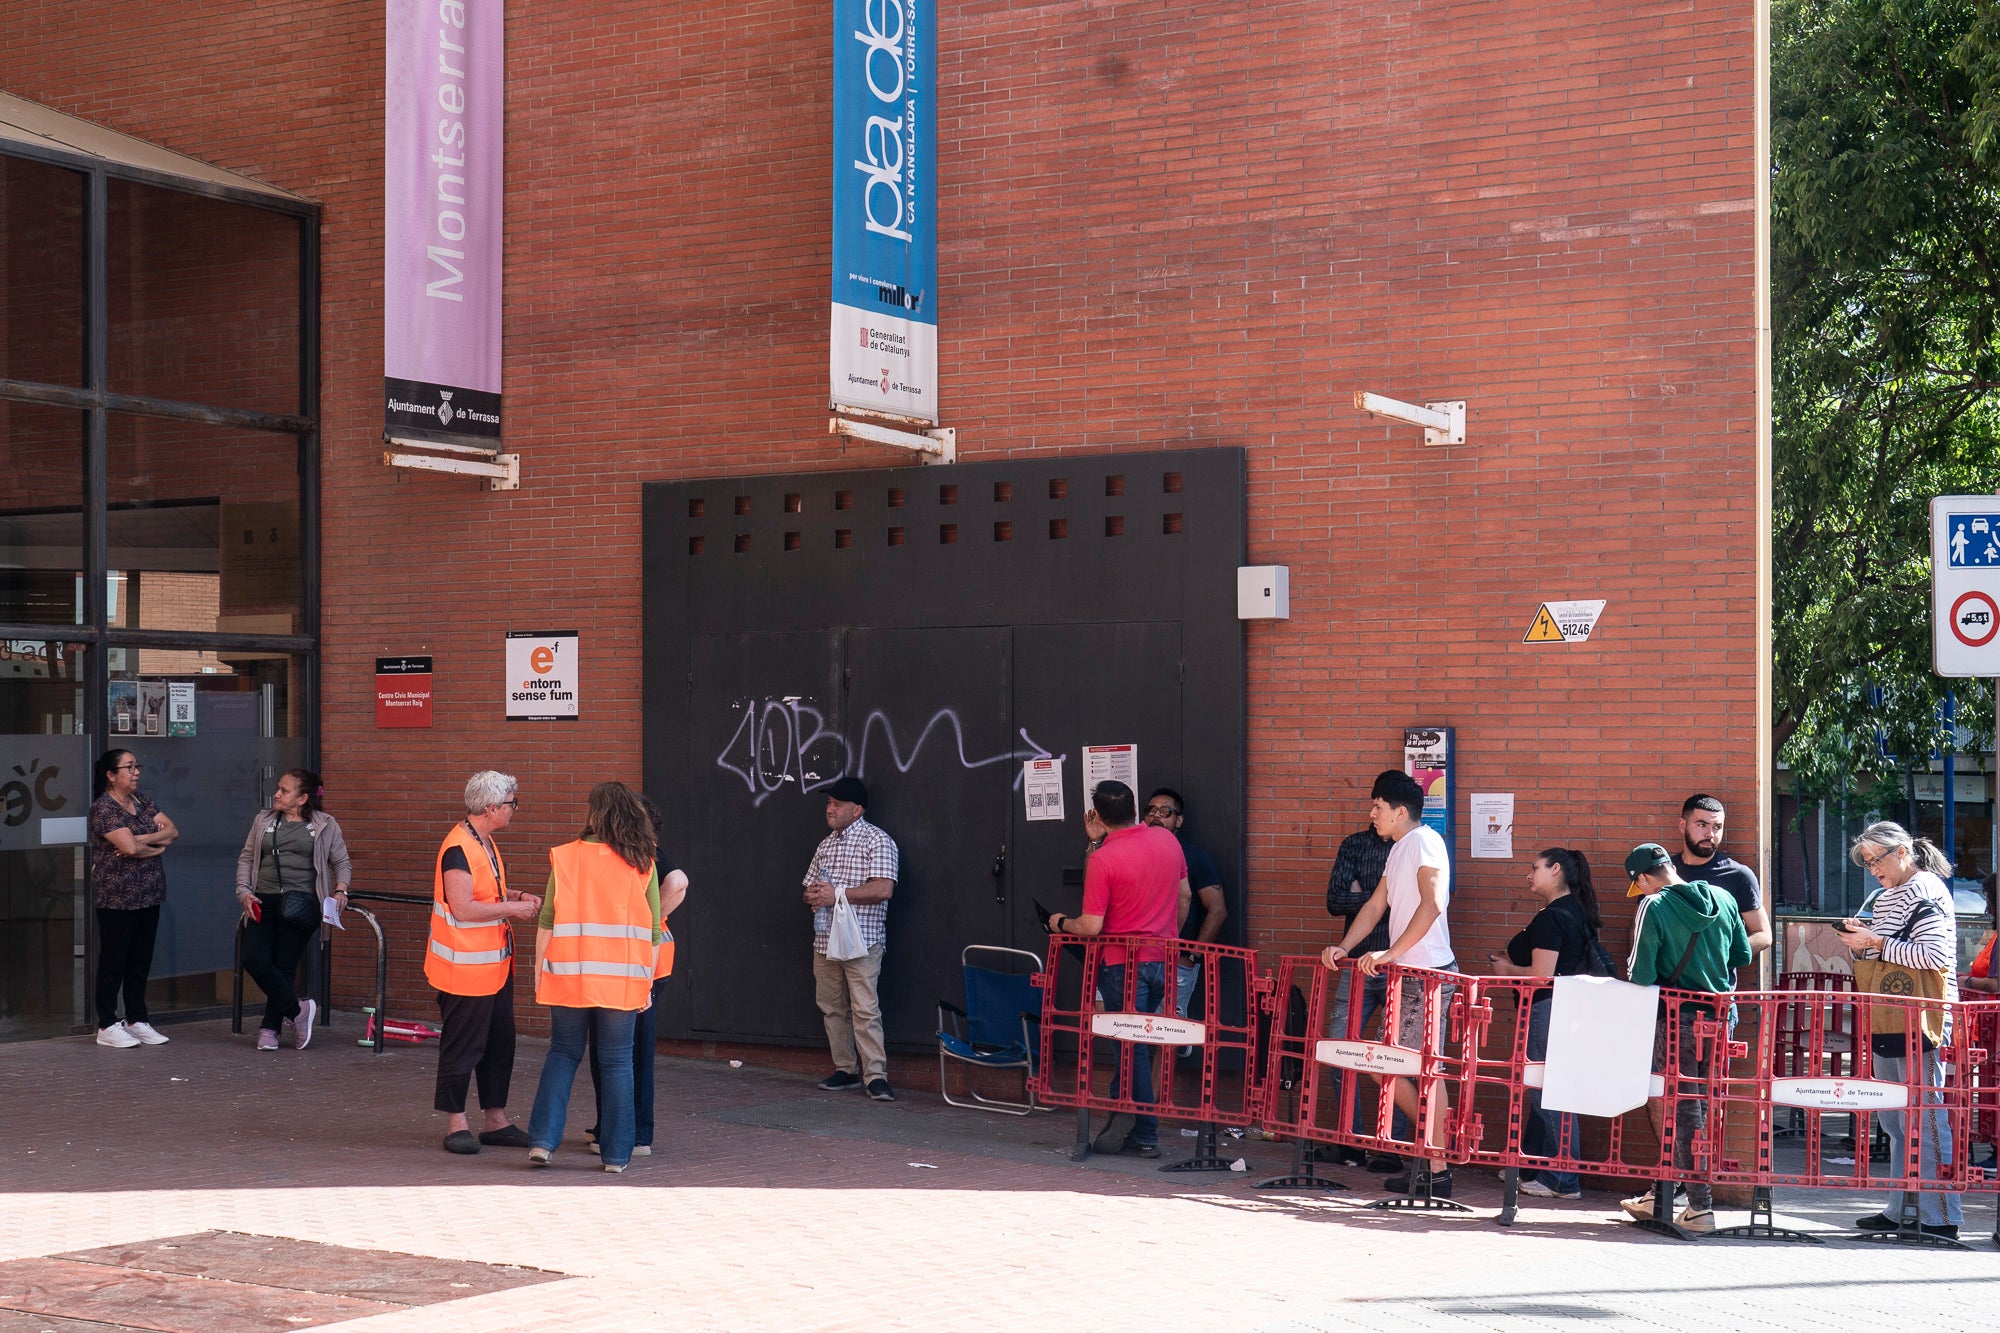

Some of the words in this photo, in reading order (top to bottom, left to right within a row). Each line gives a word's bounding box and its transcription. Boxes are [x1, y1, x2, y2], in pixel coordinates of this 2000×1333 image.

[906, 99, 916, 196] N'ANGLADA
[854, 115, 912, 243] pla
[907, 200, 916, 224] CA
[869, 328, 906, 344] Generalitat
[870, 341, 878, 350] de
[880, 342, 910, 358] Catalunya
[848, 373, 878, 388] Ajuntament
[892, 382, 898, 391] de
[899, 383, 922, 395] Terrassa
[388, 398, 435, 416] Ajuntament
[456, 408, 466, 419] de
[468, 408, 500, 424] Terrassa
[1563, 624, 1589, 635] 51246
[523, 678, 561, 689] entorn
[407, 691, 430, 700] Municipal
[512, 691, 546, 701] sense
[550, 689, 573, 701] fum
[385, 699, 411, 707] Montserrat
[1113, 1021, 1143, 1030] Ajuntament
[1164, 1026, 1186, 1034] Terrassa
[1335, 1049, 1364, 1058] Ajuntament
[1384, 1055, 1404, 1063] Terrassa
[1795, 1087, 1831, 1095] Ajuntament
